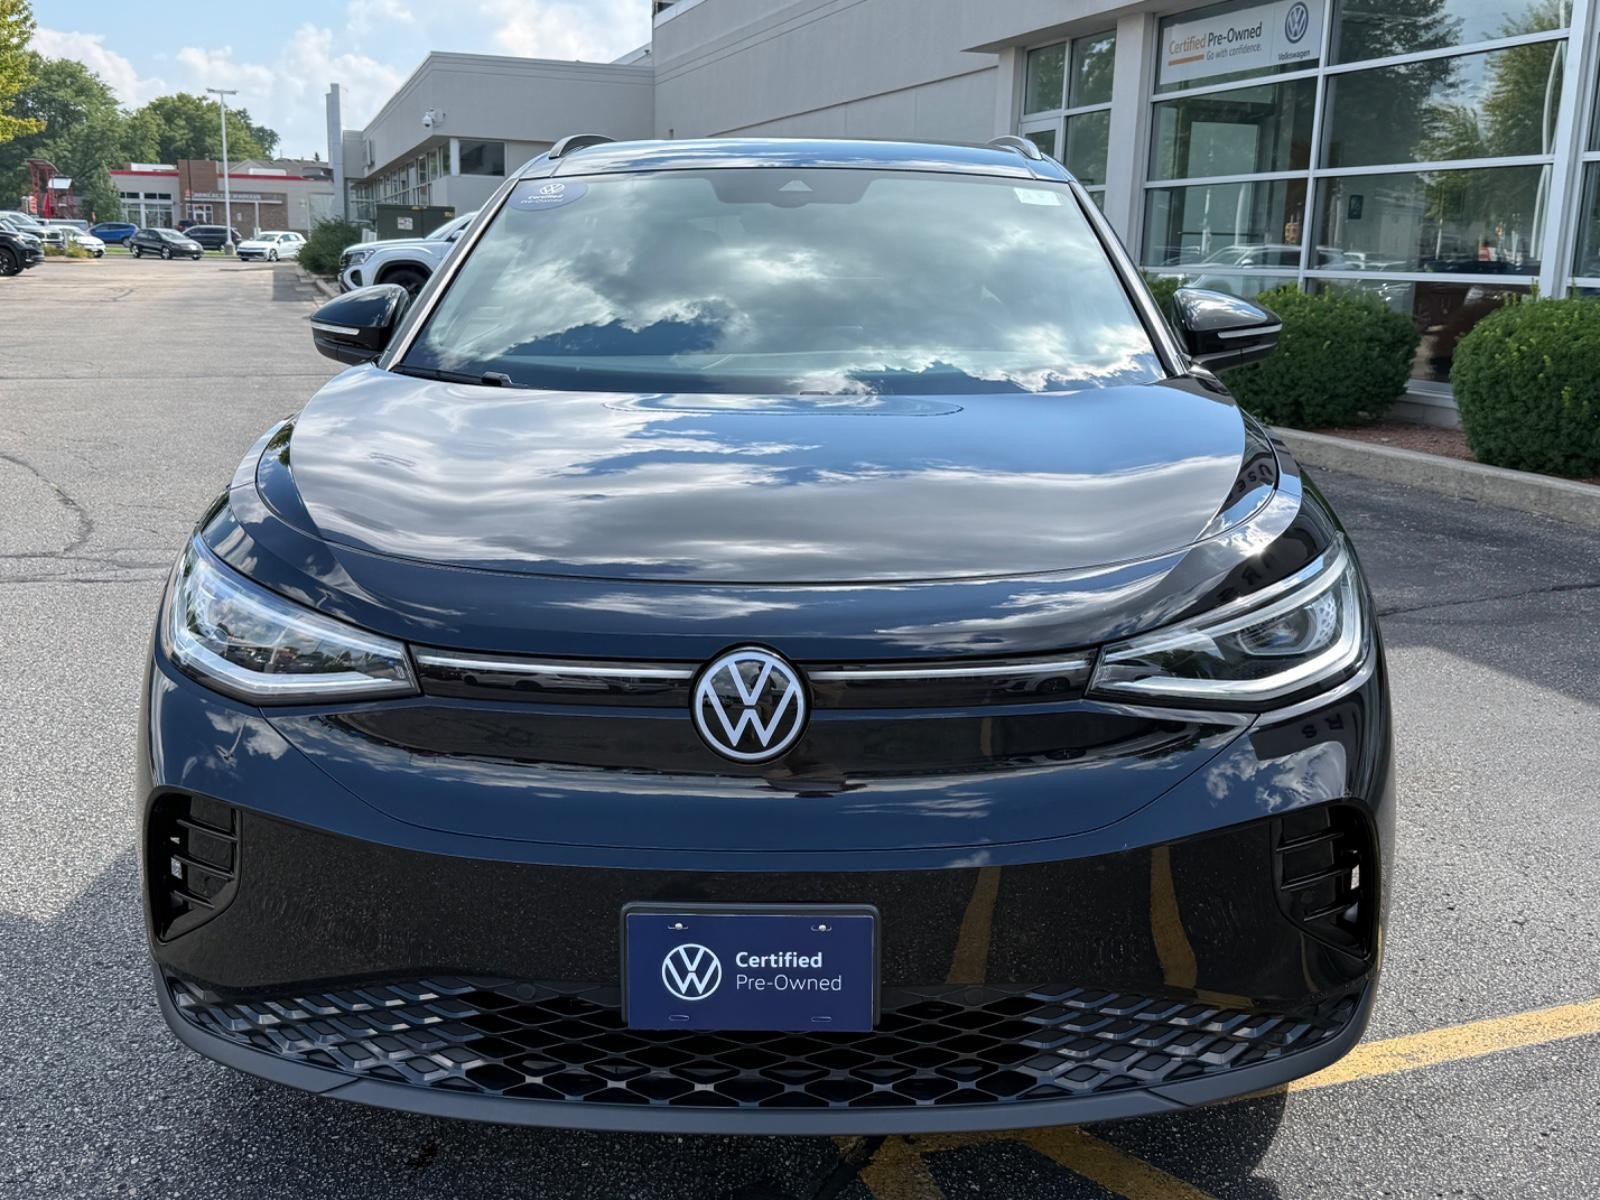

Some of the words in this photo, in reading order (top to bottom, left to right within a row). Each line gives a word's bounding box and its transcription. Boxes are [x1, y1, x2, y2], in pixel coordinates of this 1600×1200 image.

[1168, 33, 1207, 55] Certified
[1207, 21, 1263, 48] Pre-Owned
[1206, 50, 1215, 60] Go
[1215, 47, 1228, 58] with
[1278, 50, 1310, 61] Volkswagen
[695, 647, 804, 760] VW
[735, 951, 823, 968] Certified
[662, 943, 722, 1001] VW
[736, 974, 842, 991] Pre-Owned
